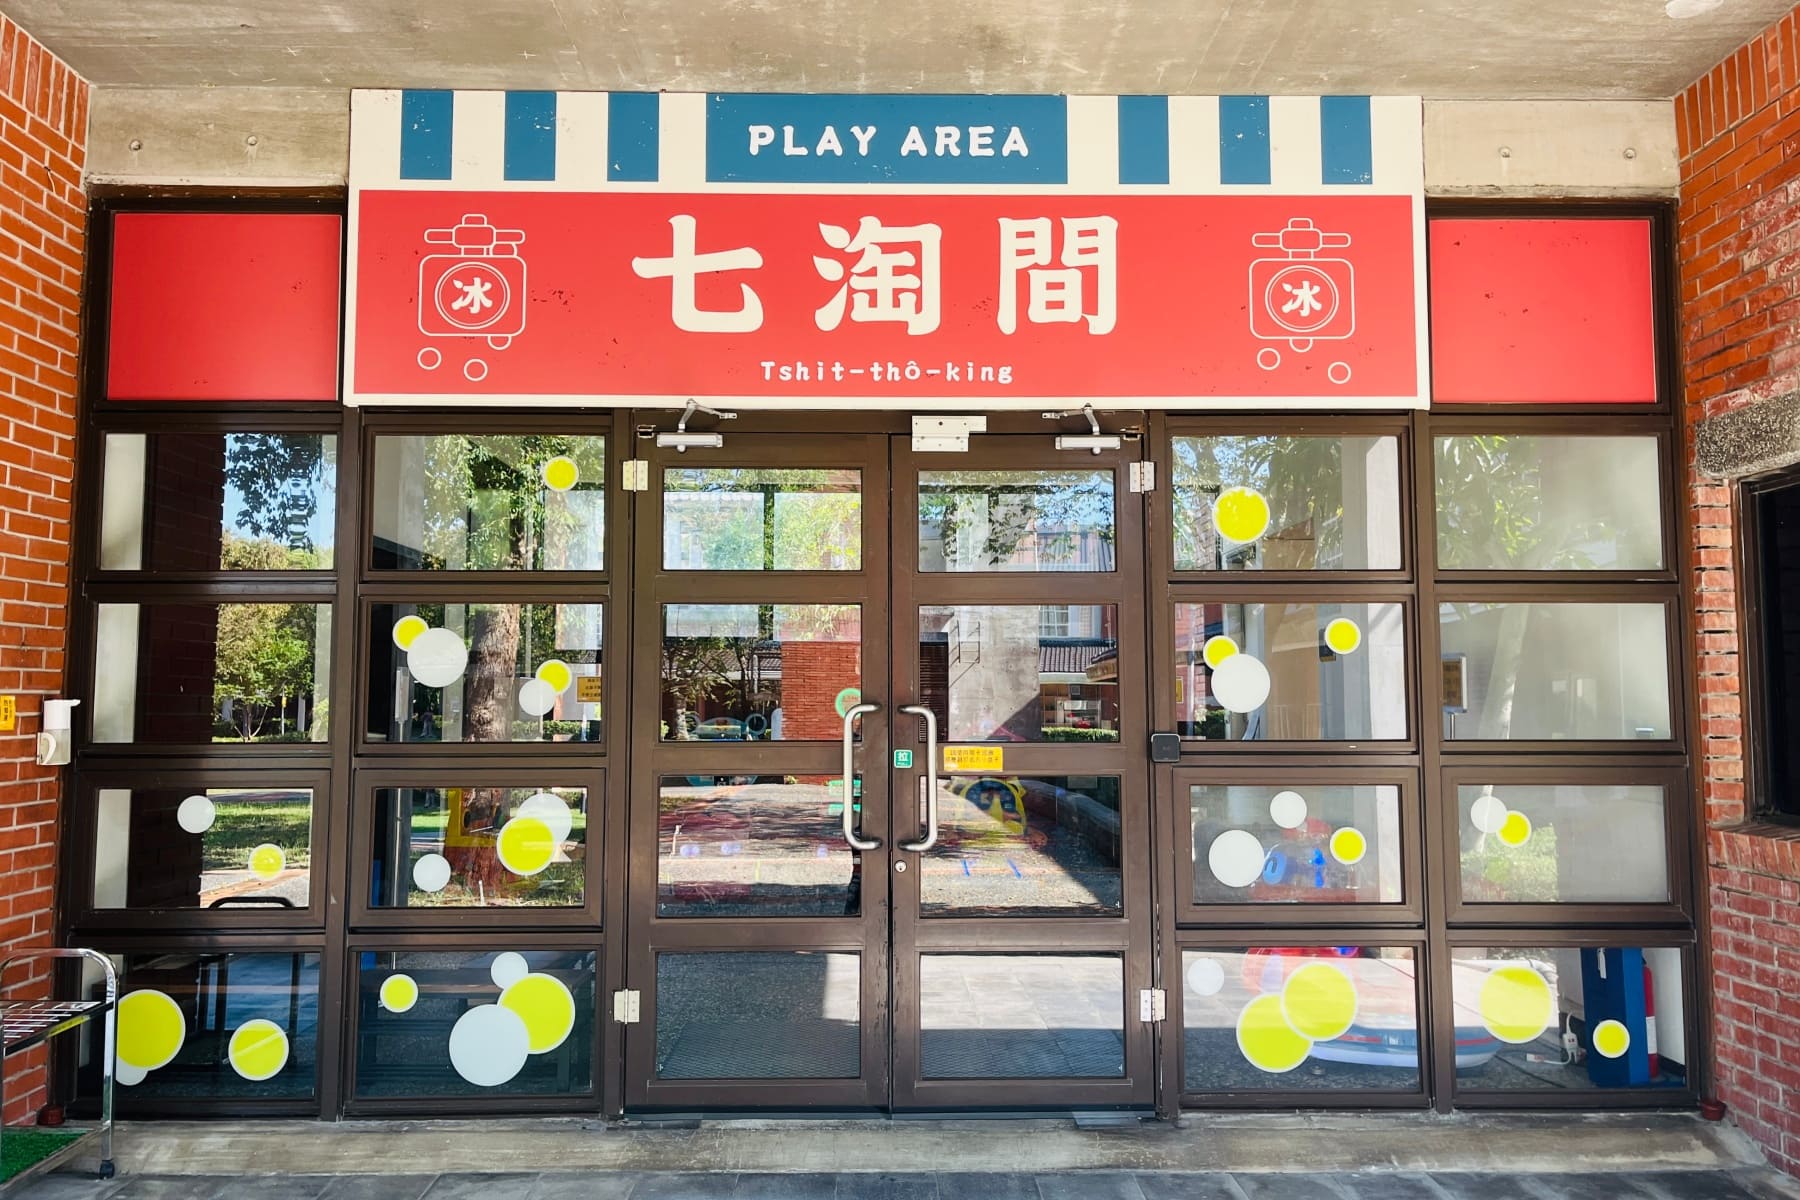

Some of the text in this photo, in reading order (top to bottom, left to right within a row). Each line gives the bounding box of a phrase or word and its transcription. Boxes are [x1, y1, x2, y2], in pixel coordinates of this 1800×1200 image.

[748, 125, 1029, 157] PLAY AREA
[631, 215, 1119, 335] 七淘間
[451, 278, 493, 314] 冰
[1281, 281, 1323, 317] 冰
[760, 360, 1013, 385] Tshit-thô-king
